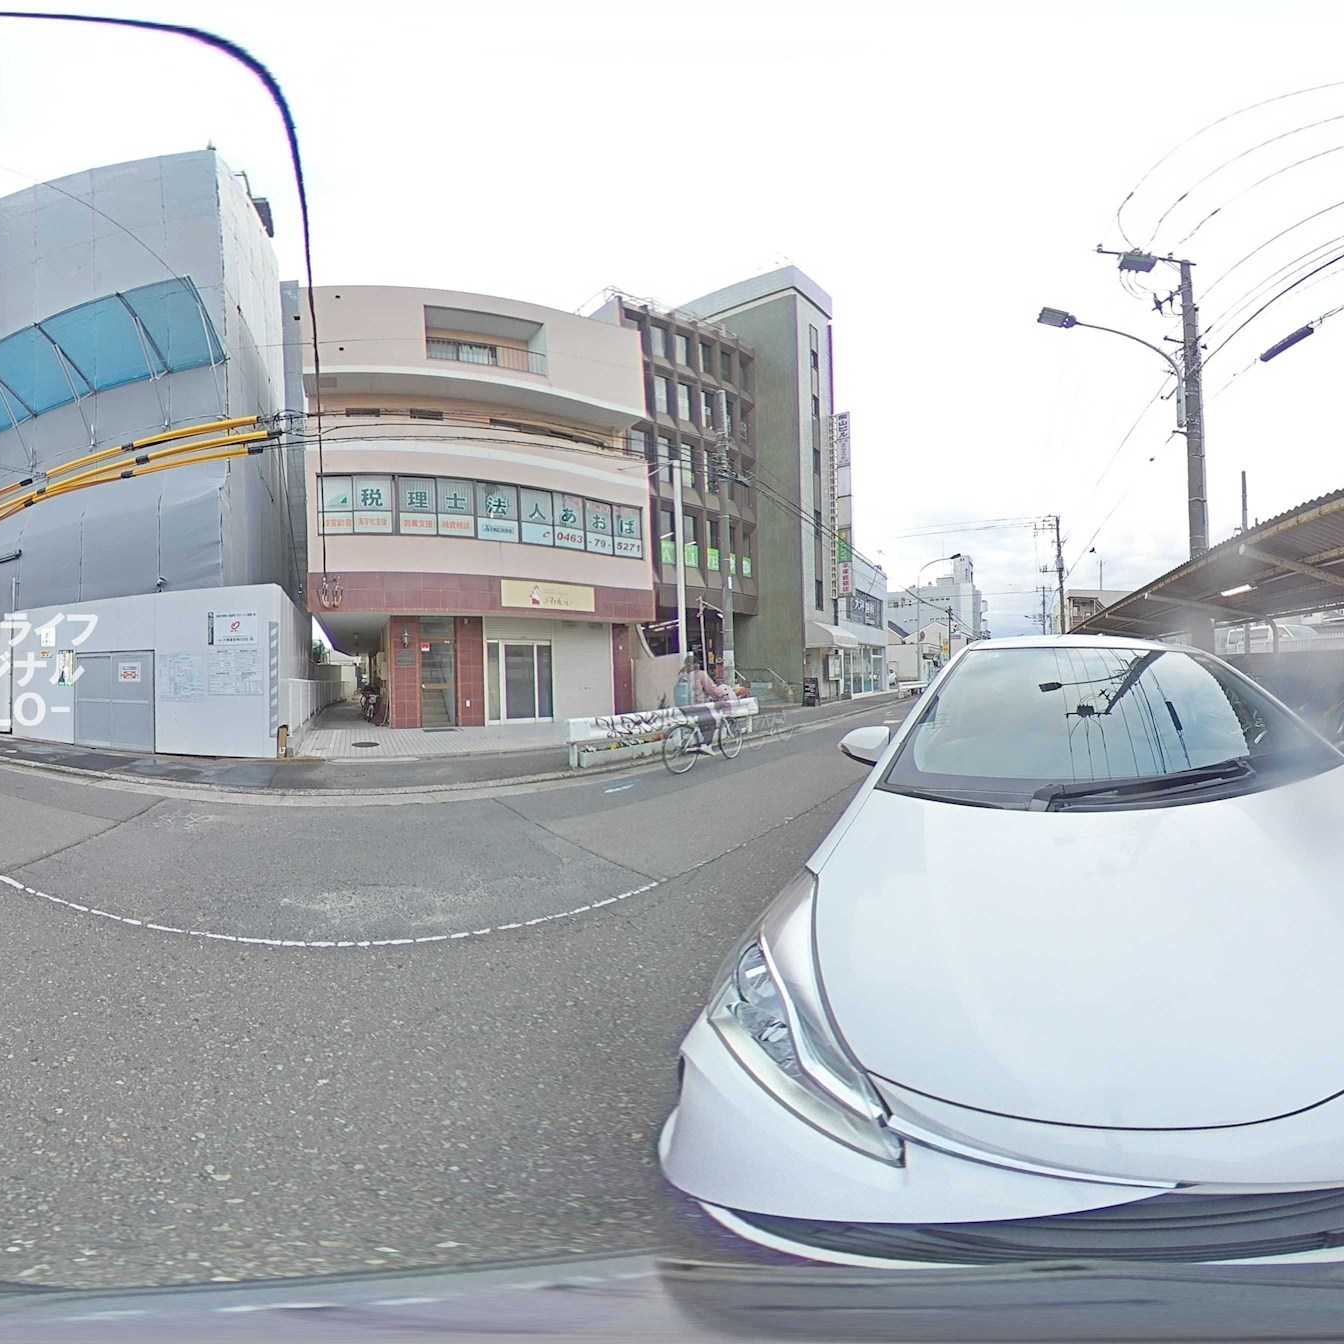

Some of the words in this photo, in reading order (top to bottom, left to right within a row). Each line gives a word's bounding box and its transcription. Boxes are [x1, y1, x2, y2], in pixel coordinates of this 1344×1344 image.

[361, 488, 635, 534] 税理士法人あおば
[556, 529, 641, 553] 0463-79-5271
